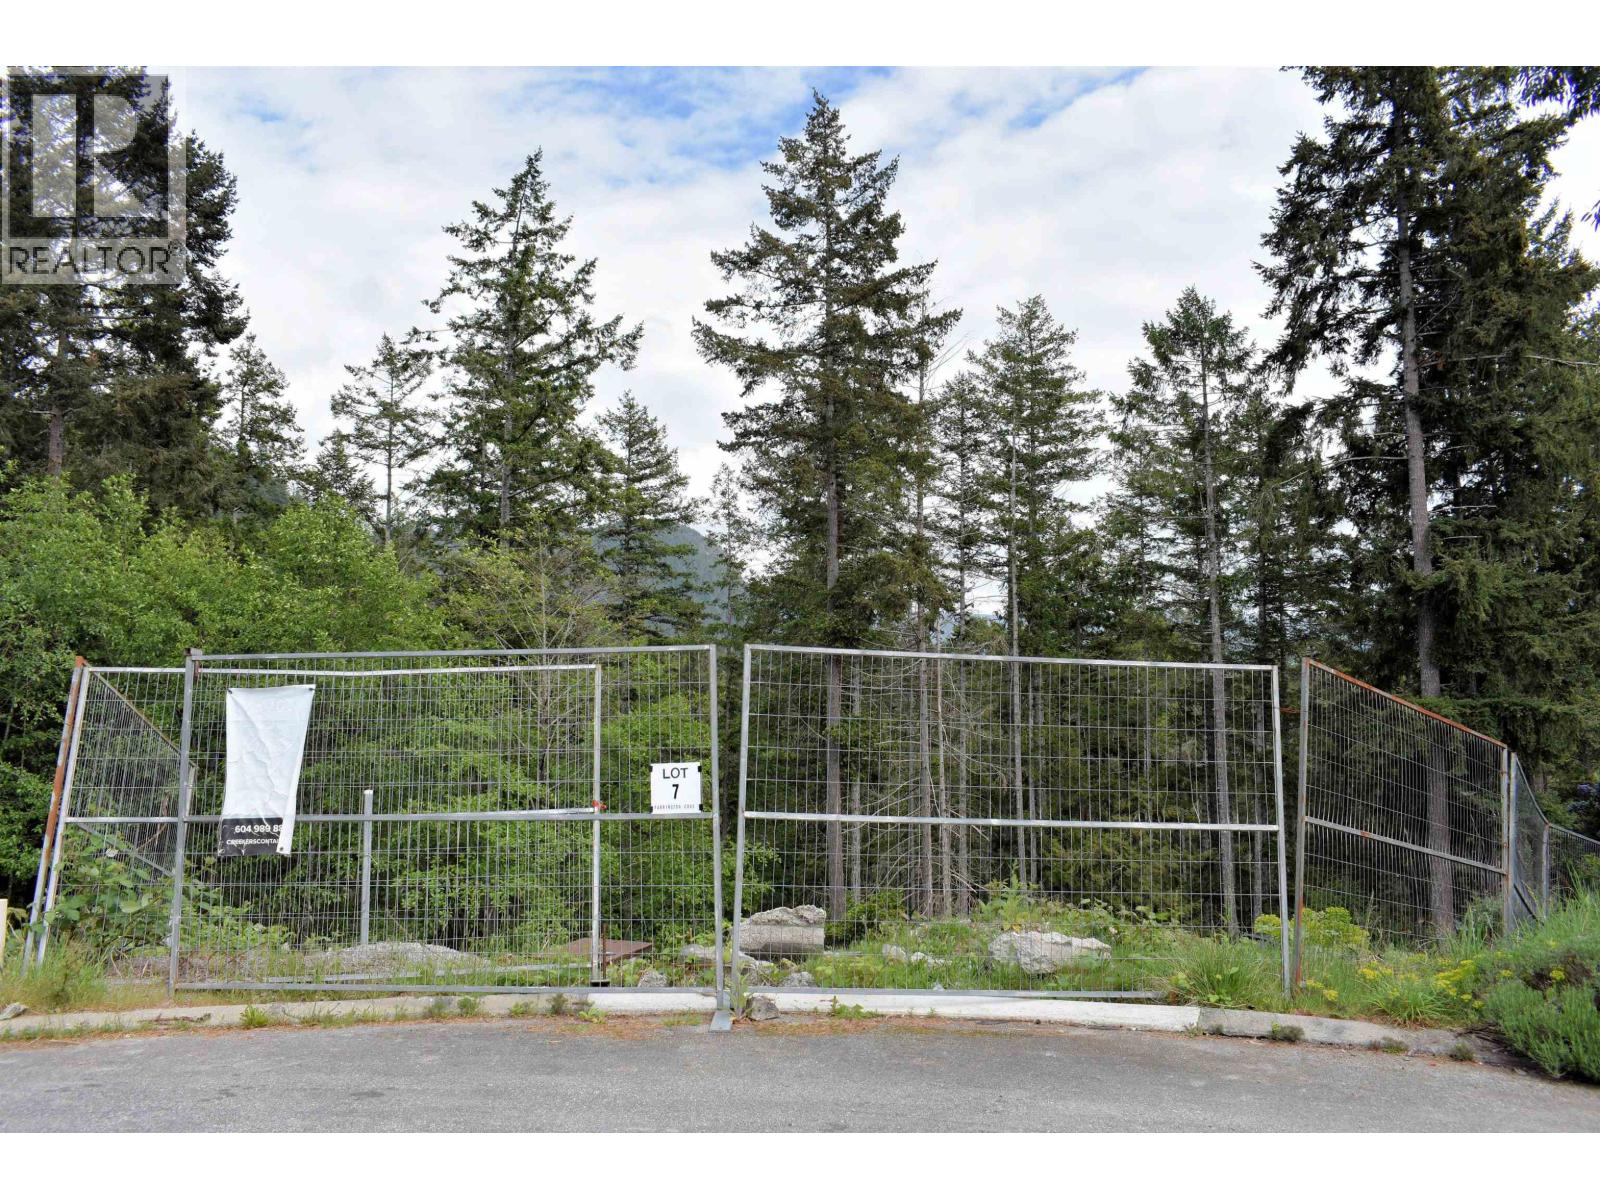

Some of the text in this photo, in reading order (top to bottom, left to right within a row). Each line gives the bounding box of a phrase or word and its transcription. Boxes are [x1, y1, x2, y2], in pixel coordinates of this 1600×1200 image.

[663, 767, 688, 779] LOT
[672, 784, 679, 799] 7
[235, 825, 251, 833] 604
[254, 824, 271, 833] 989
